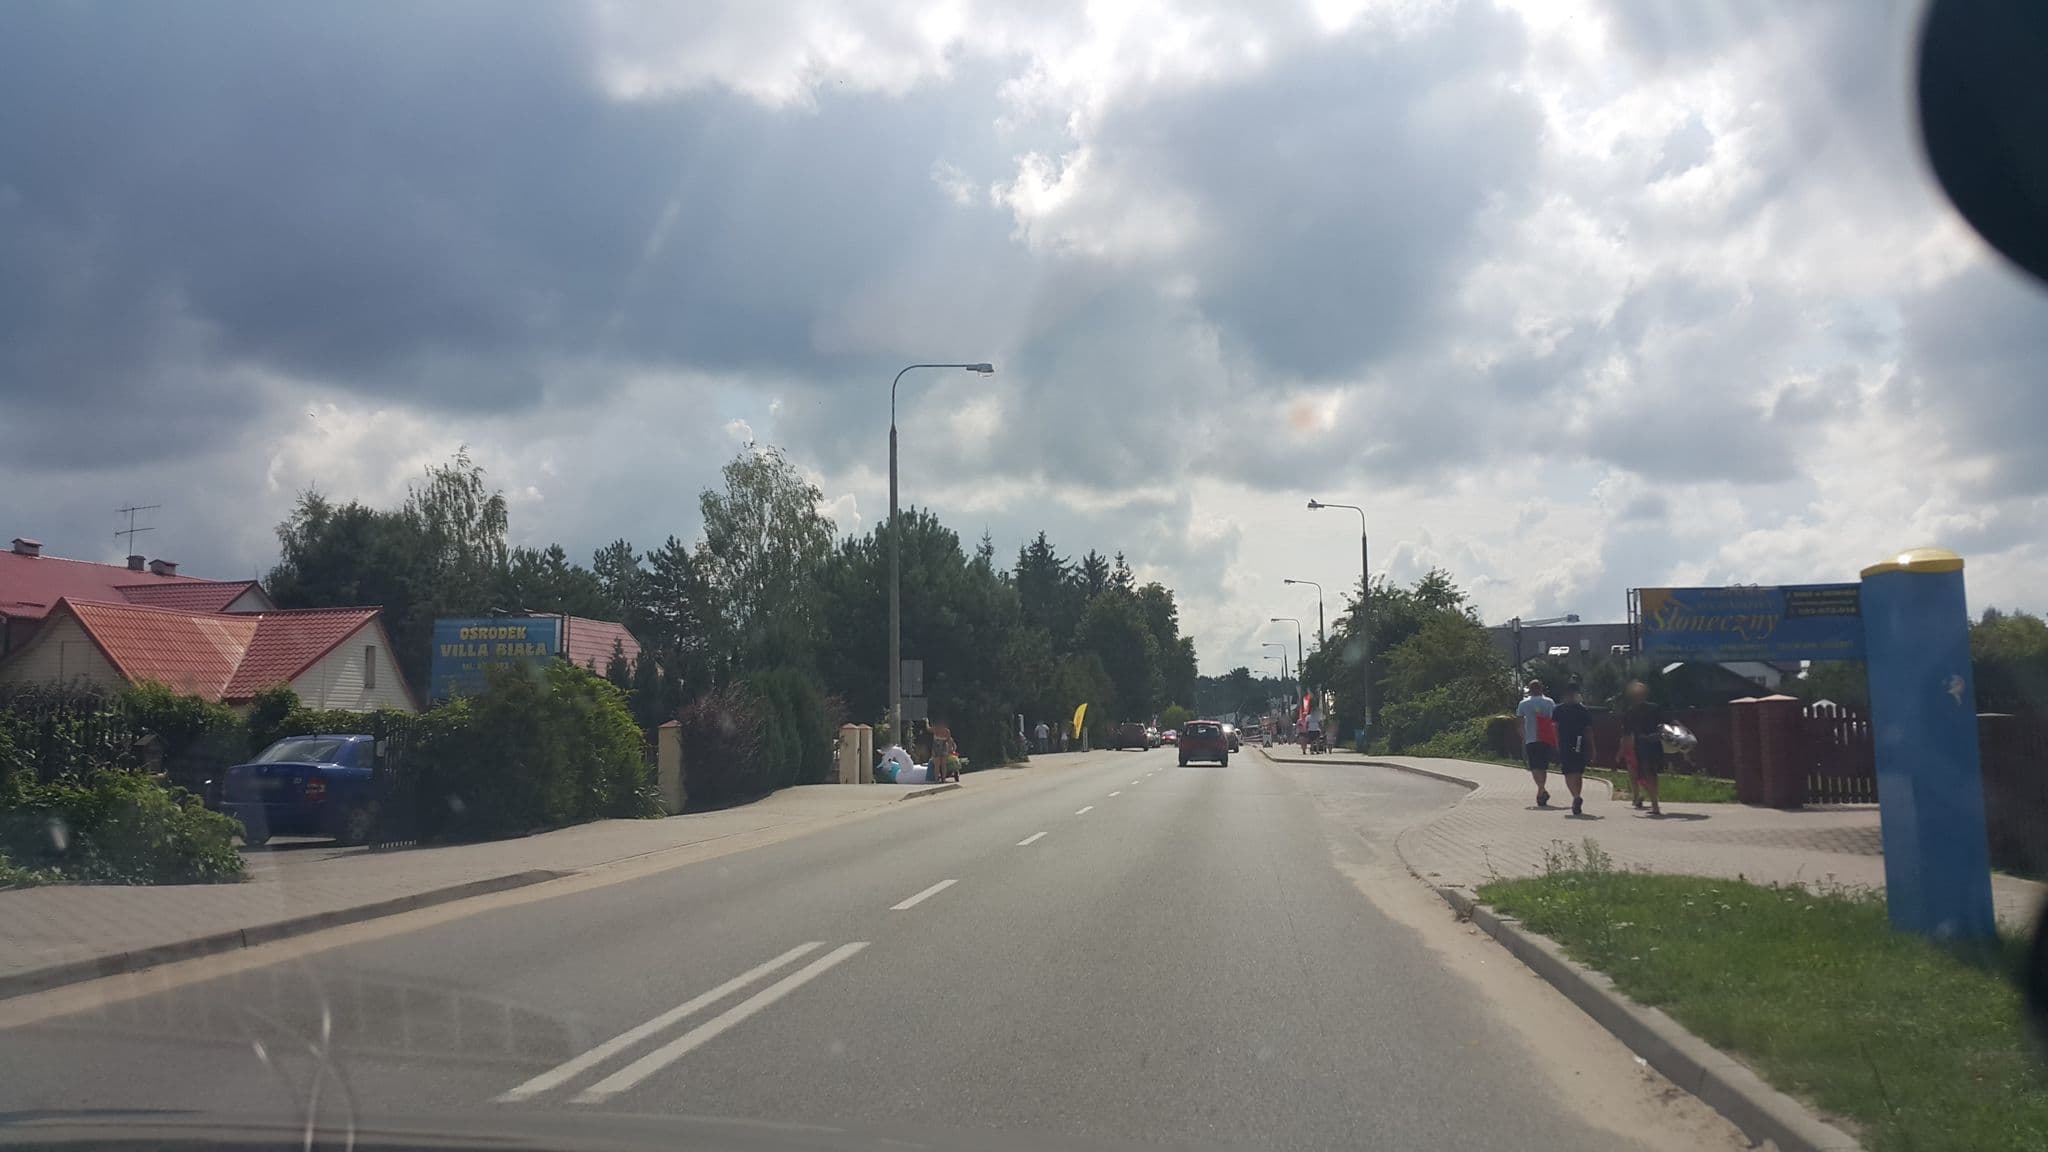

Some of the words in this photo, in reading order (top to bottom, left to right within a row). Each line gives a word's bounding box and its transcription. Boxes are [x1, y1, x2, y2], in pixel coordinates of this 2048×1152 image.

[458, 623, 528, 640] OŚRODEK
[440, 643, 489, 656] VILLA
[496, 643, 547, 656] BIAŁA
